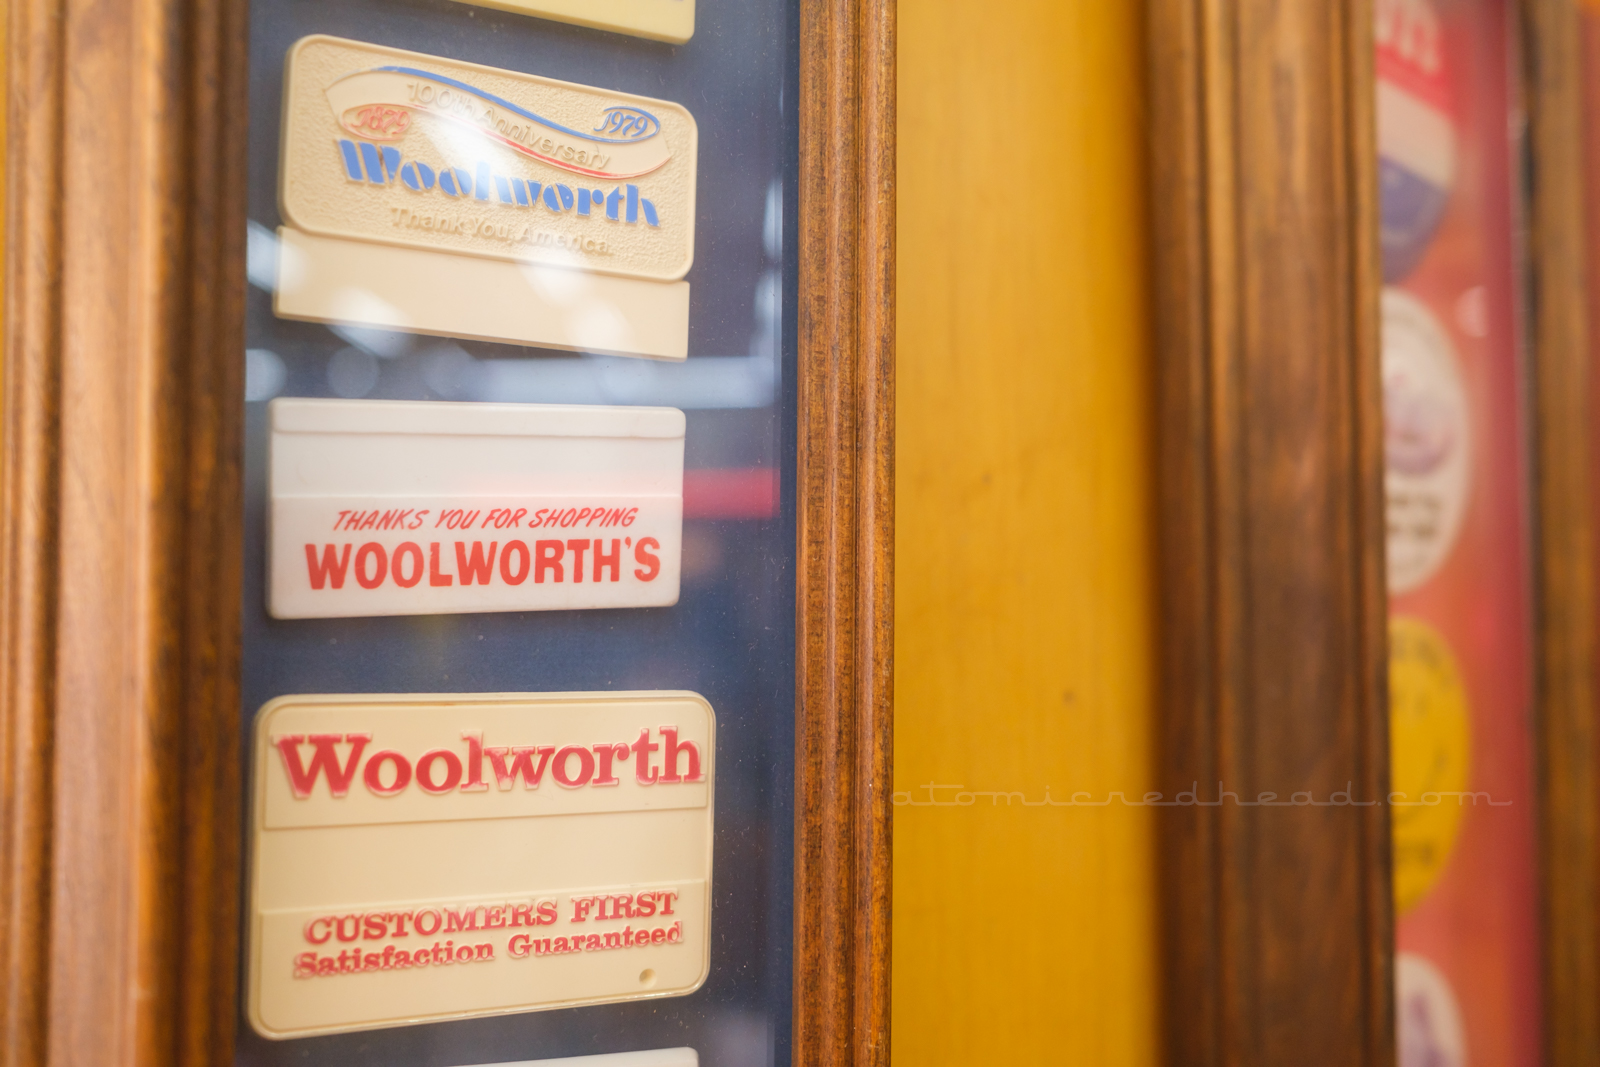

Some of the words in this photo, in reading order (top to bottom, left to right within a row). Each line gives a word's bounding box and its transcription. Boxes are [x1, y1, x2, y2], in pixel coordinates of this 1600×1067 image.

[352, 104, 412, 134] 1879
[407, 82, 477, 118] 100th
[480, 106, 611, 169] Anniversary
[593, 110, 649, 138] 1979
[334, 138, 661, 228] Woolworth
[390, 206, 465, 237] Thank
[332, 508, 430, 532] THANKS
[434, 508, 481, 531] YOU
[481, 507, 524, 530] FOR
[528, 506, 640, 529] SHOPPING
[304, 535, 661, 590] WOOLWORTH'S
[271, 725, 706, 800] Woolworth
[303, 897, 558, 946] CUSTOMERS
[570, 888, 679, 924] FIRST
[293, 939, 496, 980] Satisfaction
[507, 920, 684, 959] Guaranteed
